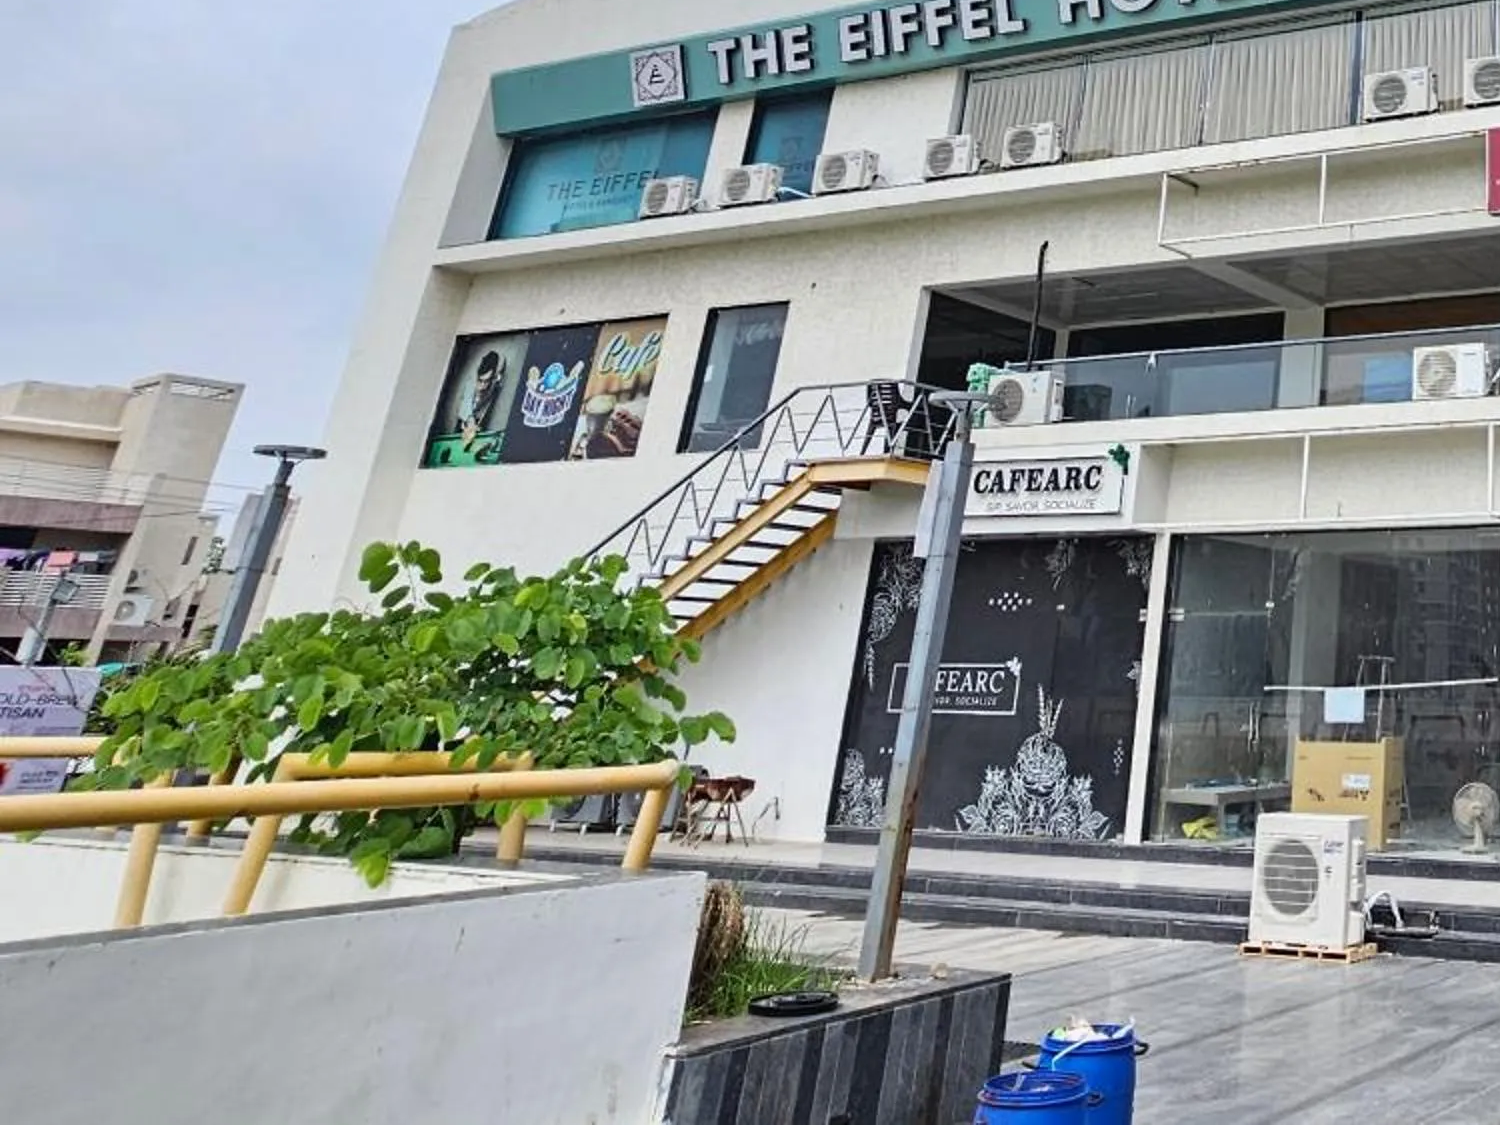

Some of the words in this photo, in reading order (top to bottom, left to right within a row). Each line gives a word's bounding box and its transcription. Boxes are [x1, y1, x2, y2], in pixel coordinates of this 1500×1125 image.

[707, 24, 815, 84] THE
[548, 180, 585, 201] THE
[973, 465, 1104, 494] CAFEARC
[934, 670, 1005, 693] FEARC
